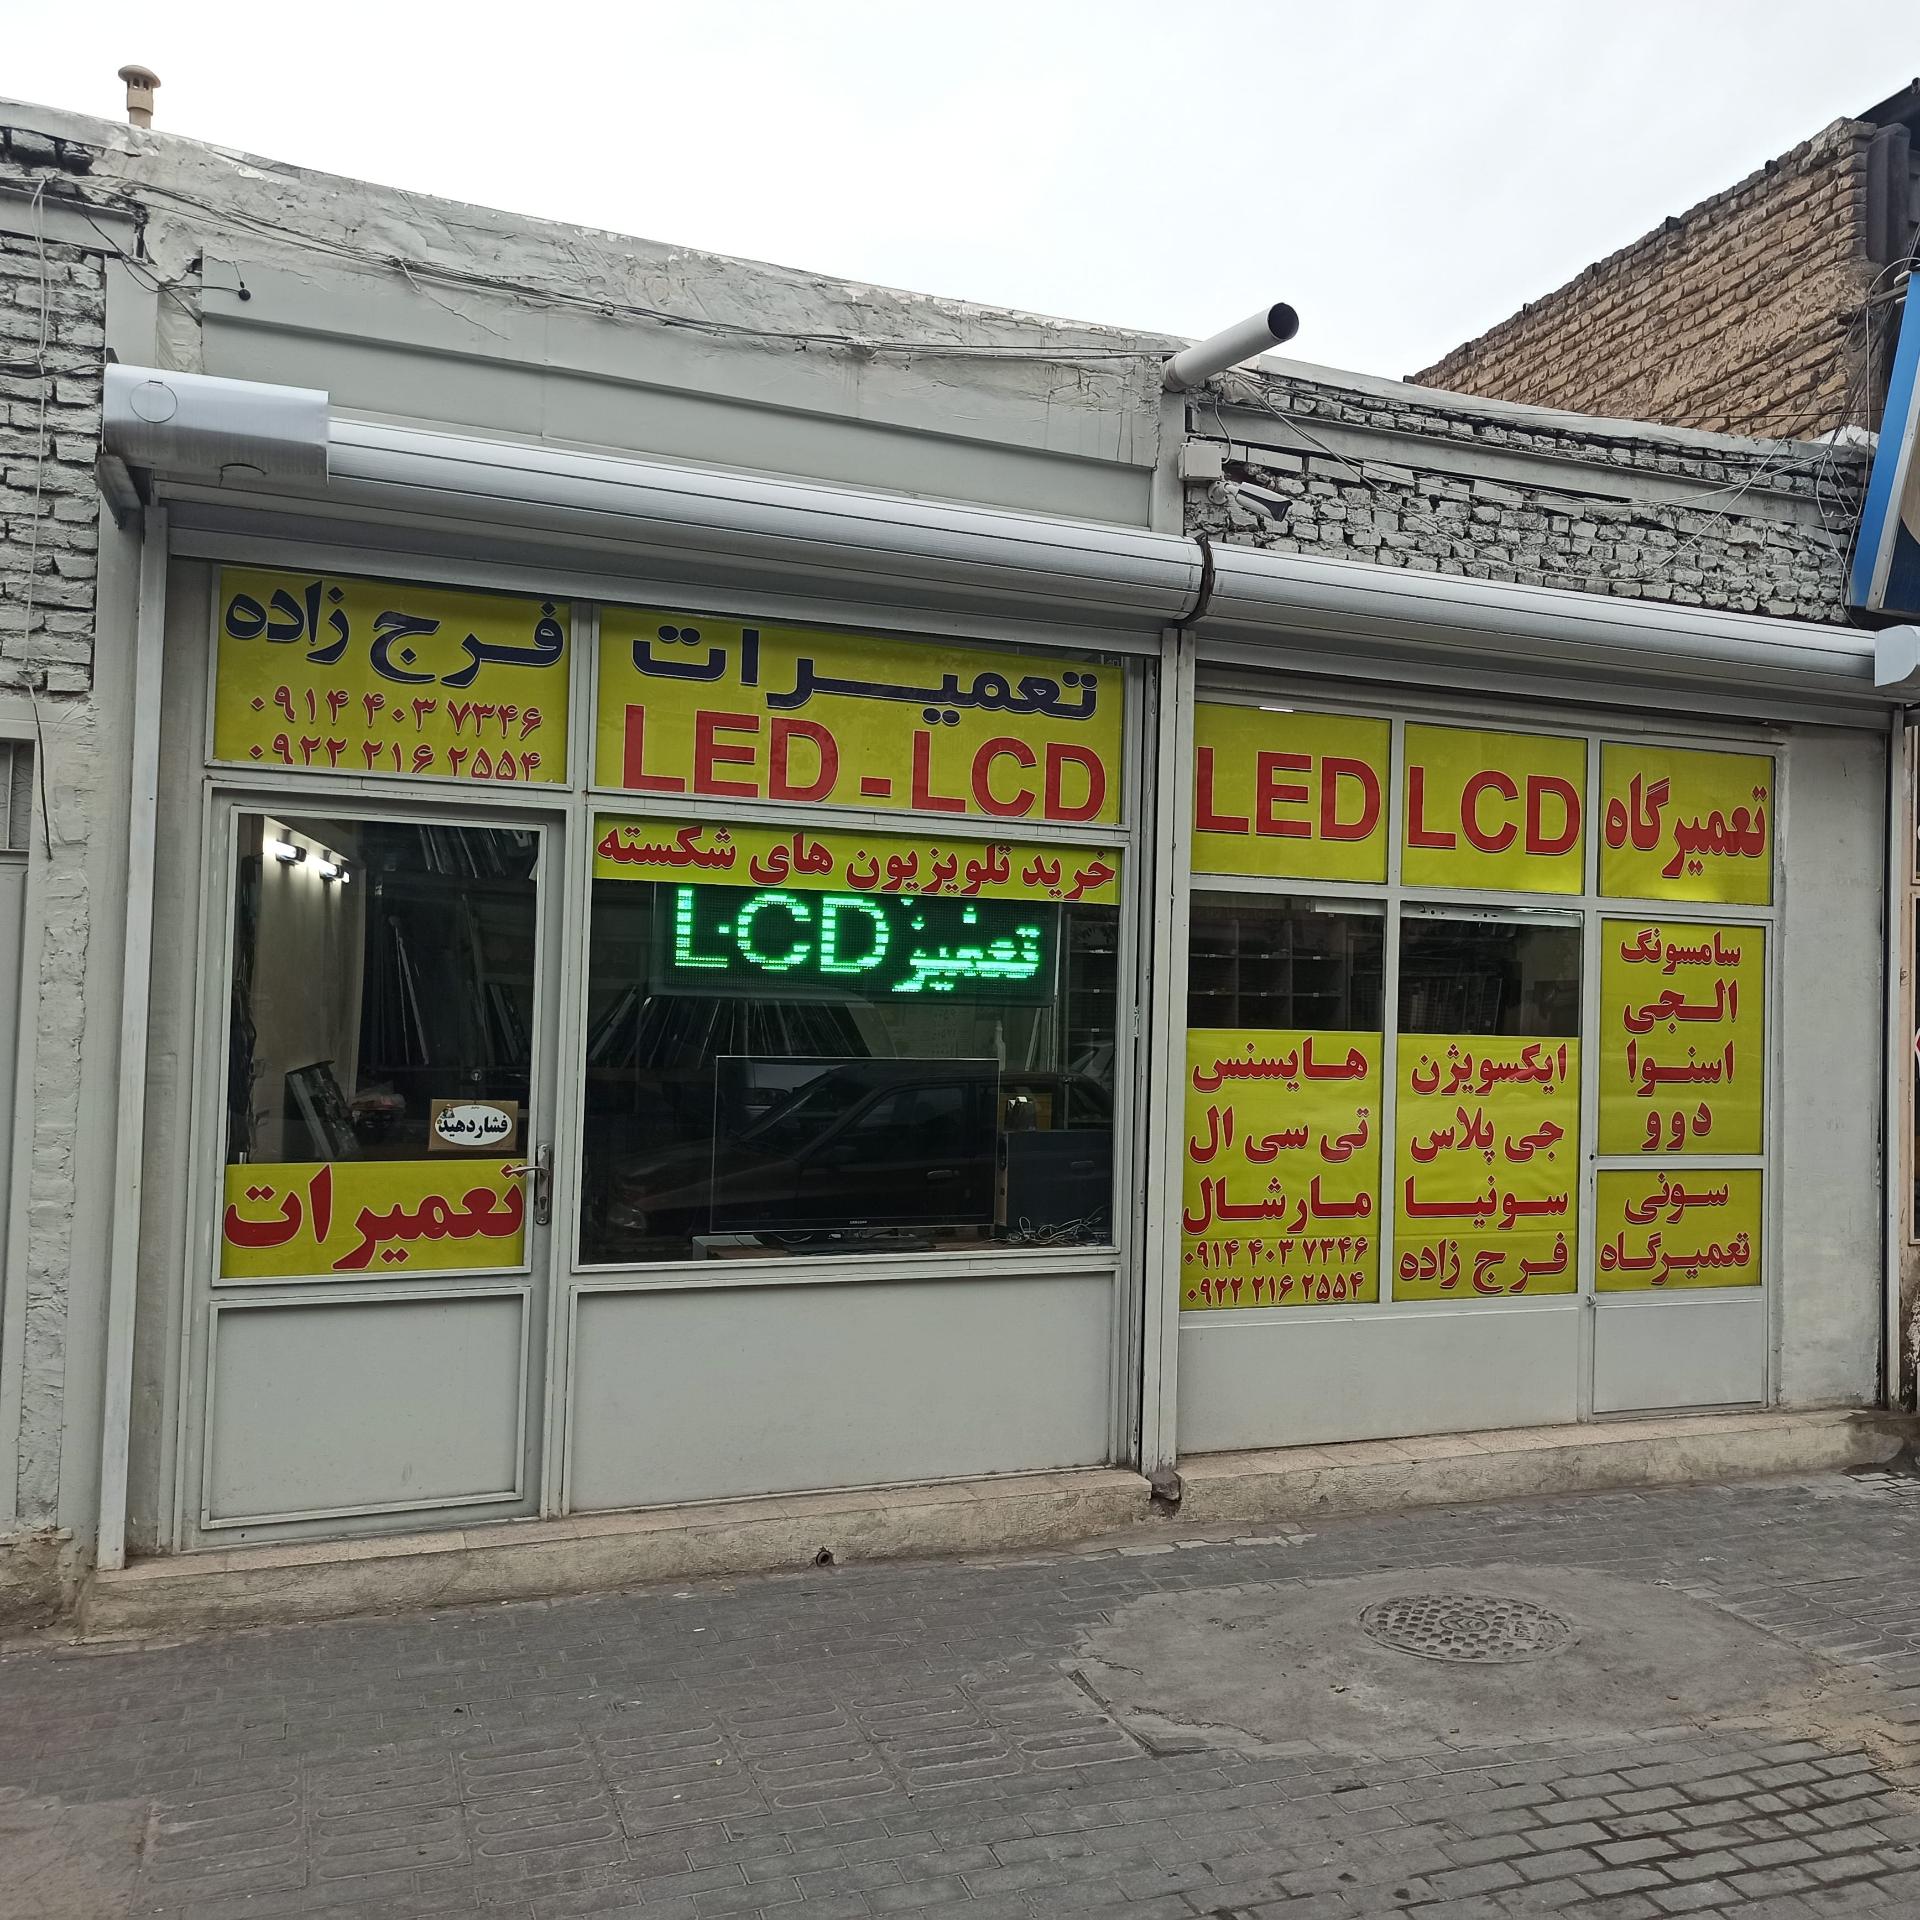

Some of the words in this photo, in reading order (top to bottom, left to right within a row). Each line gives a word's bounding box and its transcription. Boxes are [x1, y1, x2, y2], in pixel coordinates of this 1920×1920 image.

[225, 579, 350, 664] زاده
[369, 601, 565, 687] فرج
[631, 624, 1100, 726] تعمیرات
[250, 685, 350, 724] ۰۹۱۴
[361, 692, 438, 731] ۴۰۳
[447, 698, 544, 740] ۷۳۴۶
[621, 703, 840, 804] LED
[910, 729, 1107, 823] LCD
[1194, 745, 1383, 842] LED
[1406, 764, 1582, 857] LCD
[596, 824, 738, 870] شکسته
[1604, 770, 1769, 881] تعمیرگاه
[748, 831, 836, 886] های
[846, 841, 1012, 897] تلویزیون
[1022, 849, 1117, 902] خرید
[1620, 927, 1742, 975] سامسونگ
[1191, 1035, 1370, 1093] هایسنس
[1409, 1042, 1570, 1097] ایکسویژن
[1625, 1037, 1736, 1097] اسنوا
[1188, 1104, 1235, 1164] ال
[1243, 1123, 1311, 1163] سی
[1319, 1107, 1371, 1163] تی
[1410, 1105, 1496, 1164] پلاس
[1503, 1119, 1567, 1163] جی
[223, 1162, 526, 1272] تعمیرات
[1182, 1174, 1375, 1235] مارشال
[1403, 1174, 1570, 1231] سونیا
[1623, 1172, 1731, 1225] سونی
[1398, 1237, 1462, 1289] زاده
[1471, 1231, 1570, 1293] فرج
[1599, 1231, 1752, 1286] تعمیرگاه
